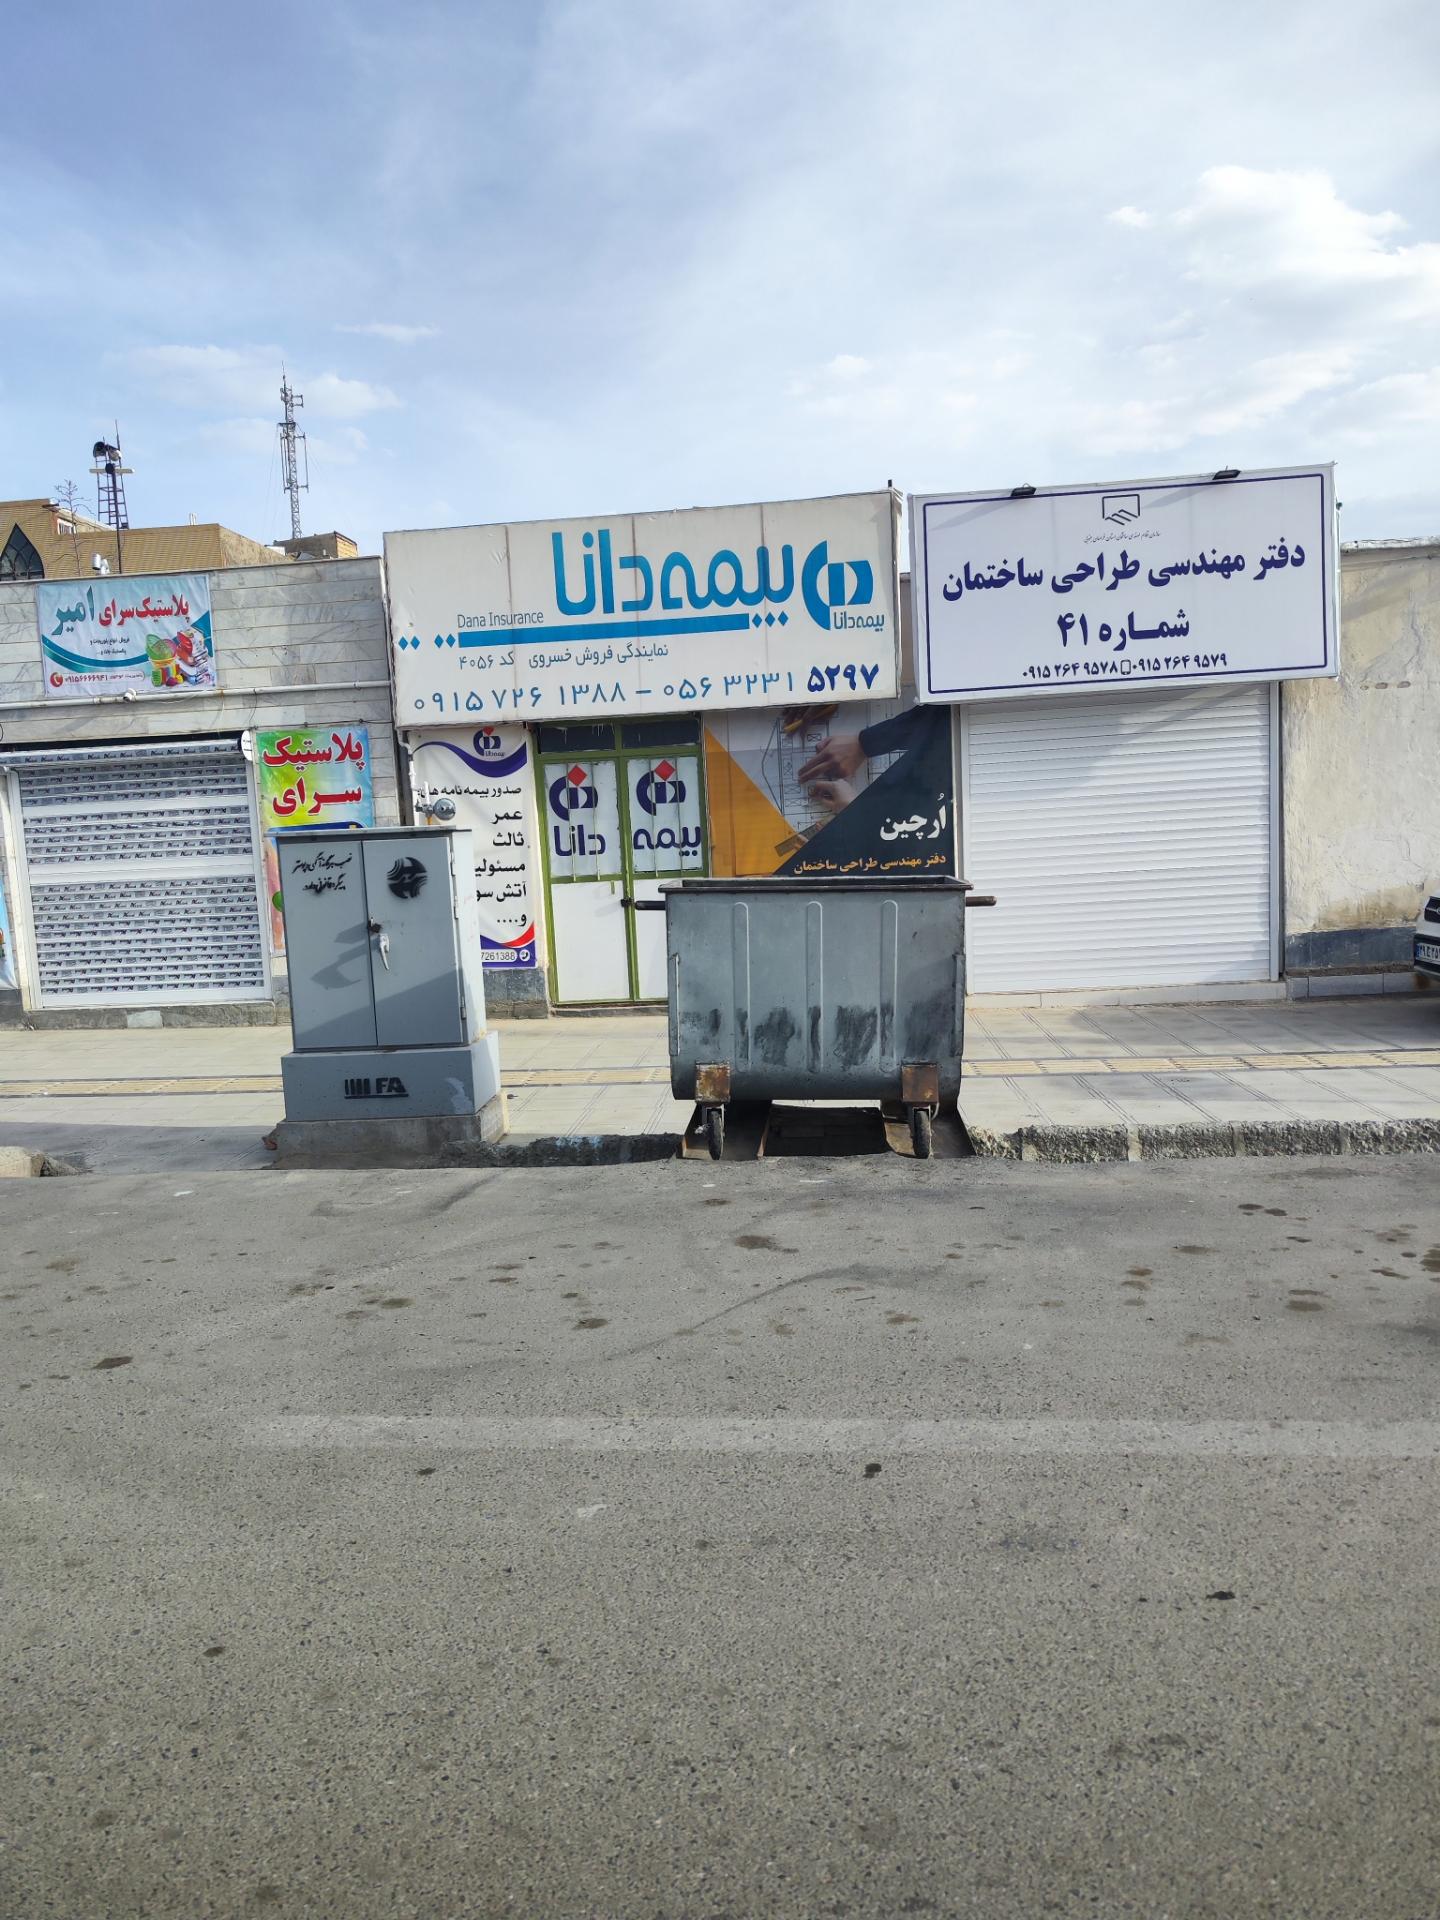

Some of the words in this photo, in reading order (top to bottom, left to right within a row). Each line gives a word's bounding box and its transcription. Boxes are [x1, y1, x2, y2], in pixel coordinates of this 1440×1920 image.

[1148, 549, 1246, 587] مهندسی
[1253, 537, 1305, 580] دفتر
[551, 528, 654, 616] دانا
[943, 557, 1044, 601] ساختمان
[1051, 550, 1140, 593] طراحی
[660, 543, 795, 628] بیمه
[52, 585, 95, 635] امیر
[99, 598, 135, 626] سرای
[136, 593, 190, 623] پلاستیک
[457, 613, 487, 628] Dana
[489, 610, 544, 627] Insurance
[1057, 612, 1089, 647] ۴۱
[1099, 609, 1190, 651] شماره
[458, 655, 494, 669] ۴۰۵۶
[499, 651, 515, 666] کد
[528, 649, 572, 668] خسروی
[576, 644, 613, 666] فروش
[617, 641, 669, 664] نمایندگی
[807, 664, 879, 692] ۵۲۹۷
[263, 732, 366, 771] پلاستیک
[273, 777, 362, 815] سرای
[441, 784, 462, 795] نامه
[464, 786, 489, 799] بیمه
[491, 785, 522, 798] صدور
[491, 810, 523, 825] عمر
[492, 831, 524, 847] ثالث
[553, 824, 606, 857] دانا
[633, 826, 701, 857] بیمه
[475, 858, 526, 877] مسئولی
[793, 859, 837, 875] ساختمان
[840, 857, 878, 872] طراحی
[880, 856, 922, 870] مهندسی
[925, 852, 946, 868] دفتر
[476, 889, 494, 902] سو
[496, 881, 527, 902] آتش
[481, 952, 516, 961] 7261388
